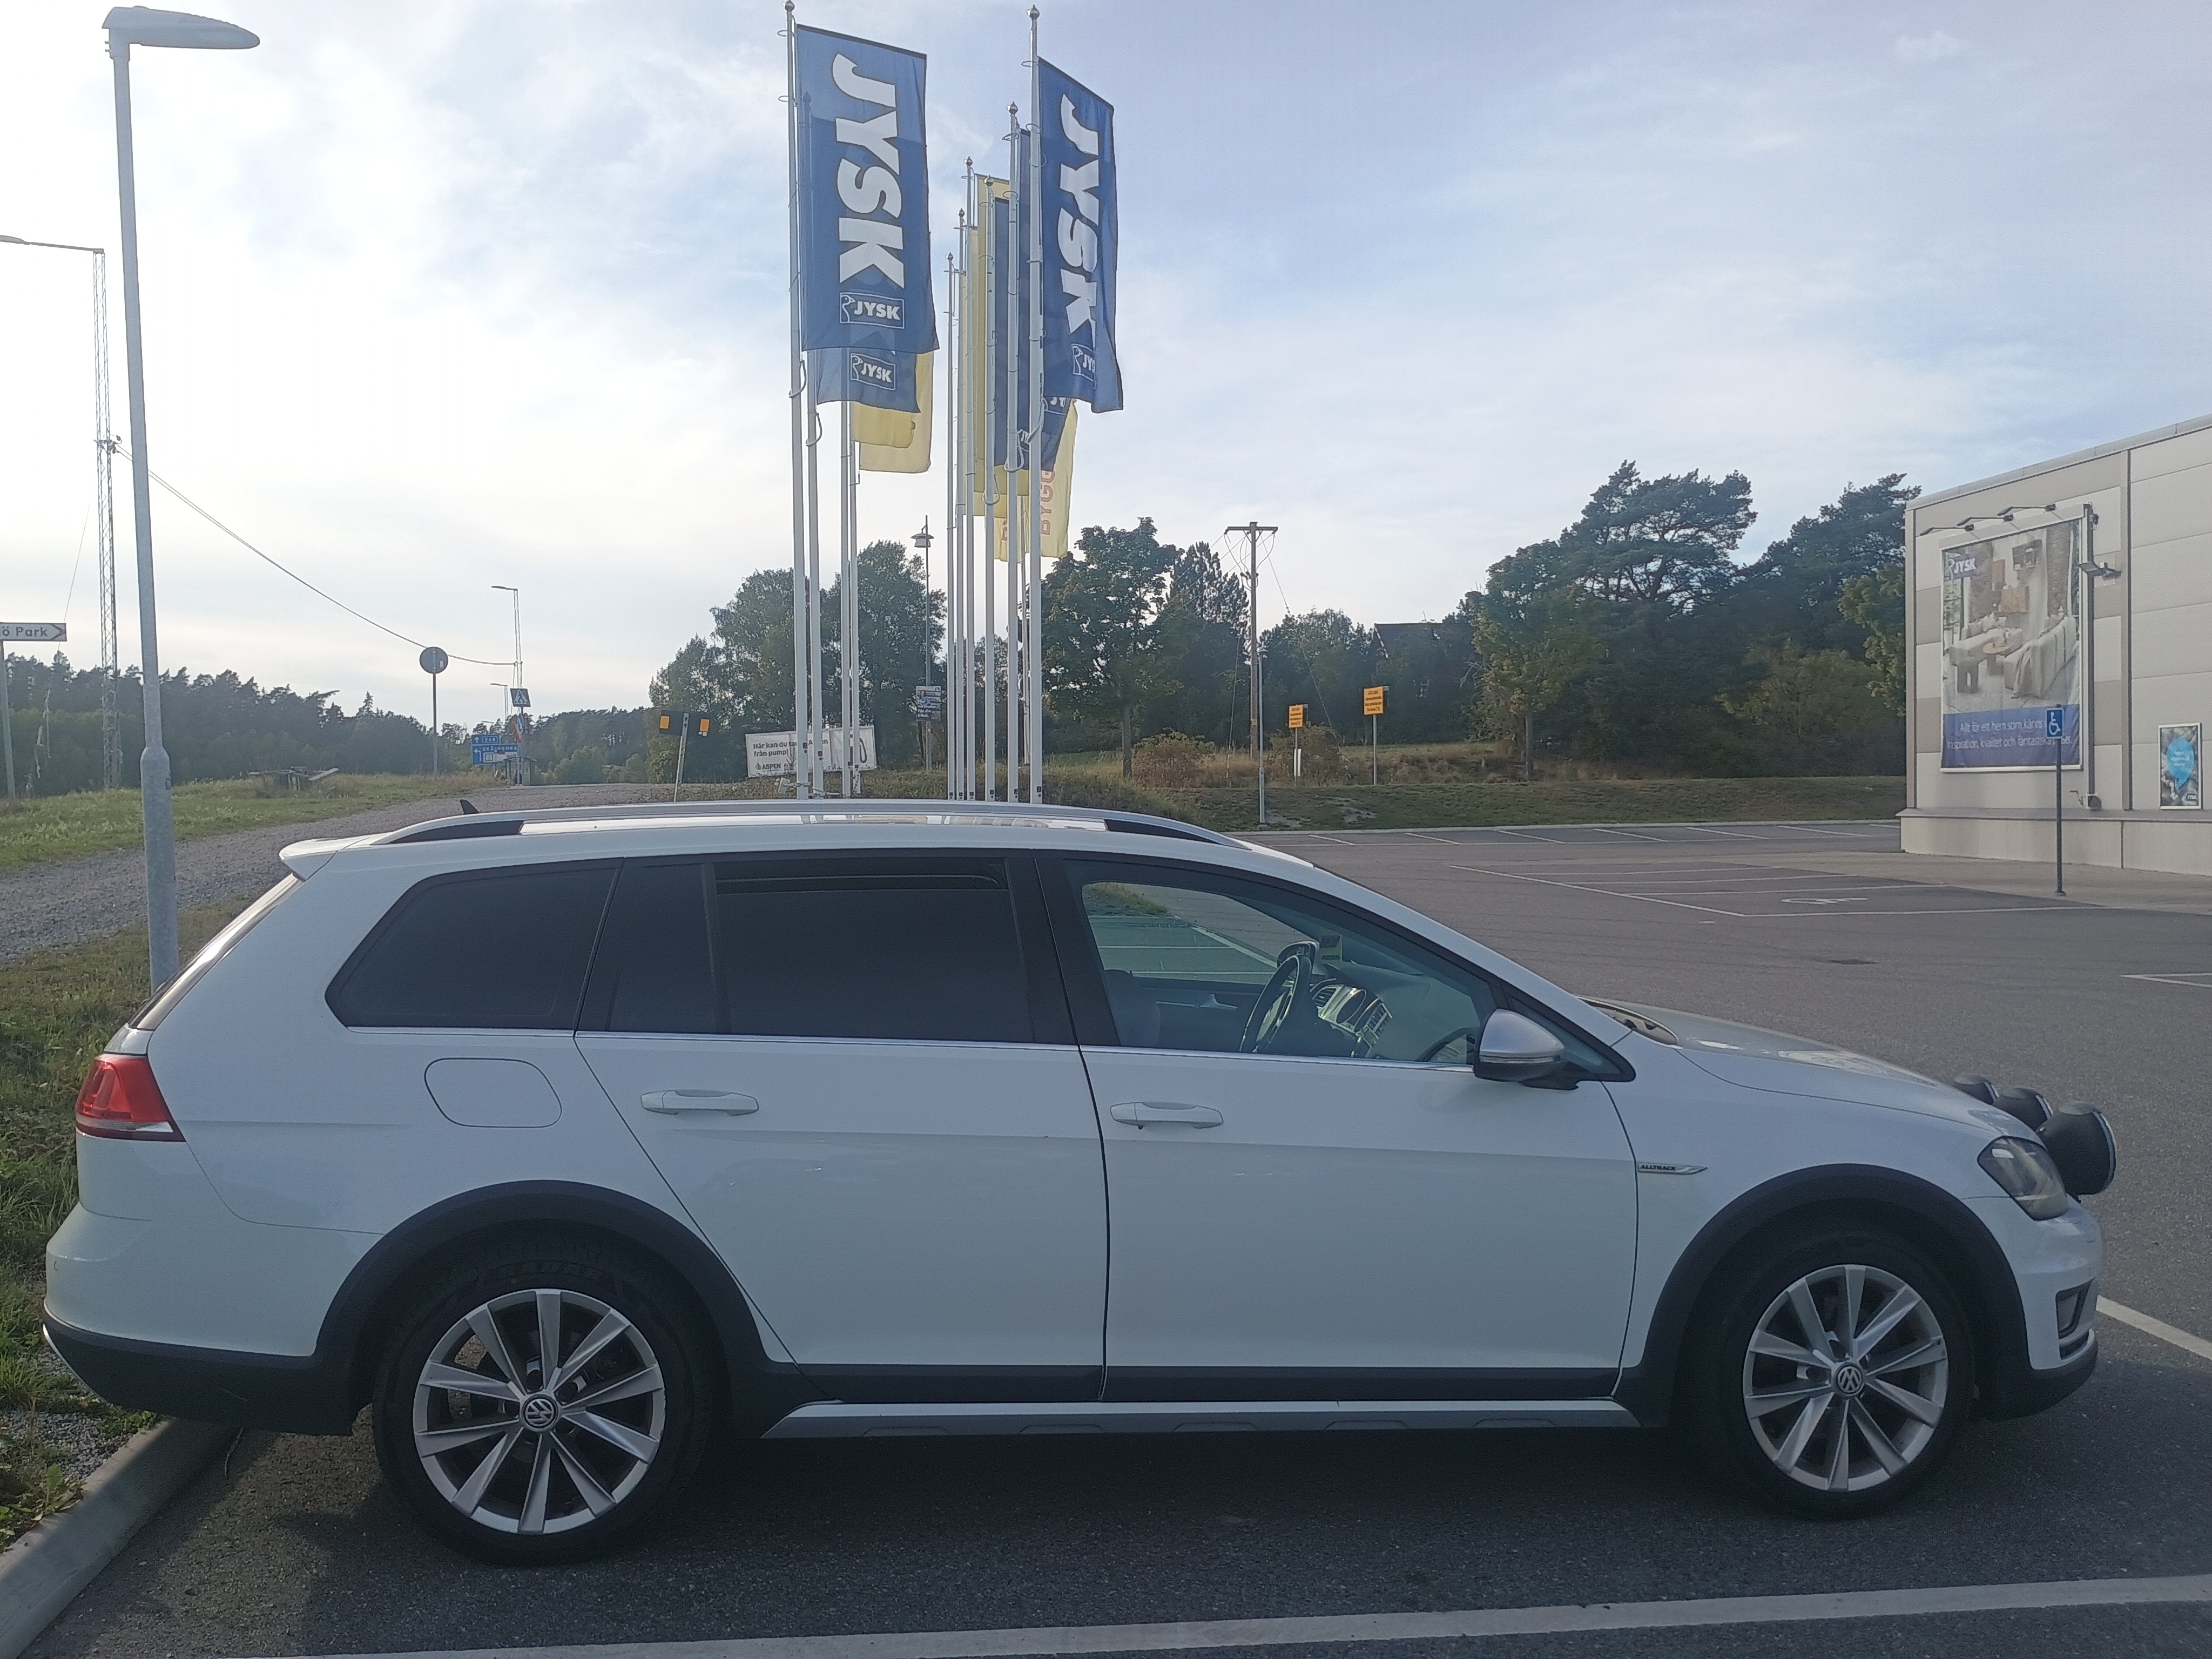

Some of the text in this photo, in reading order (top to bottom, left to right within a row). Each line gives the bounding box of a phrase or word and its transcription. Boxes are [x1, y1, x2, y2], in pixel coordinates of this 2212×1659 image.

[832, 53, 905, 289] JYSK
[1057, 93, 1100, 348] JYSK
[854, 301, 900, 320] JYSK
[861, 363, 892, 382] JYSK
[1082, 354, 1095, 374] JYS
[1953, 558, 1977, 574] JYSK
[16, 627, 48, 637] Park
[768, 749, 788, 757] pump!
